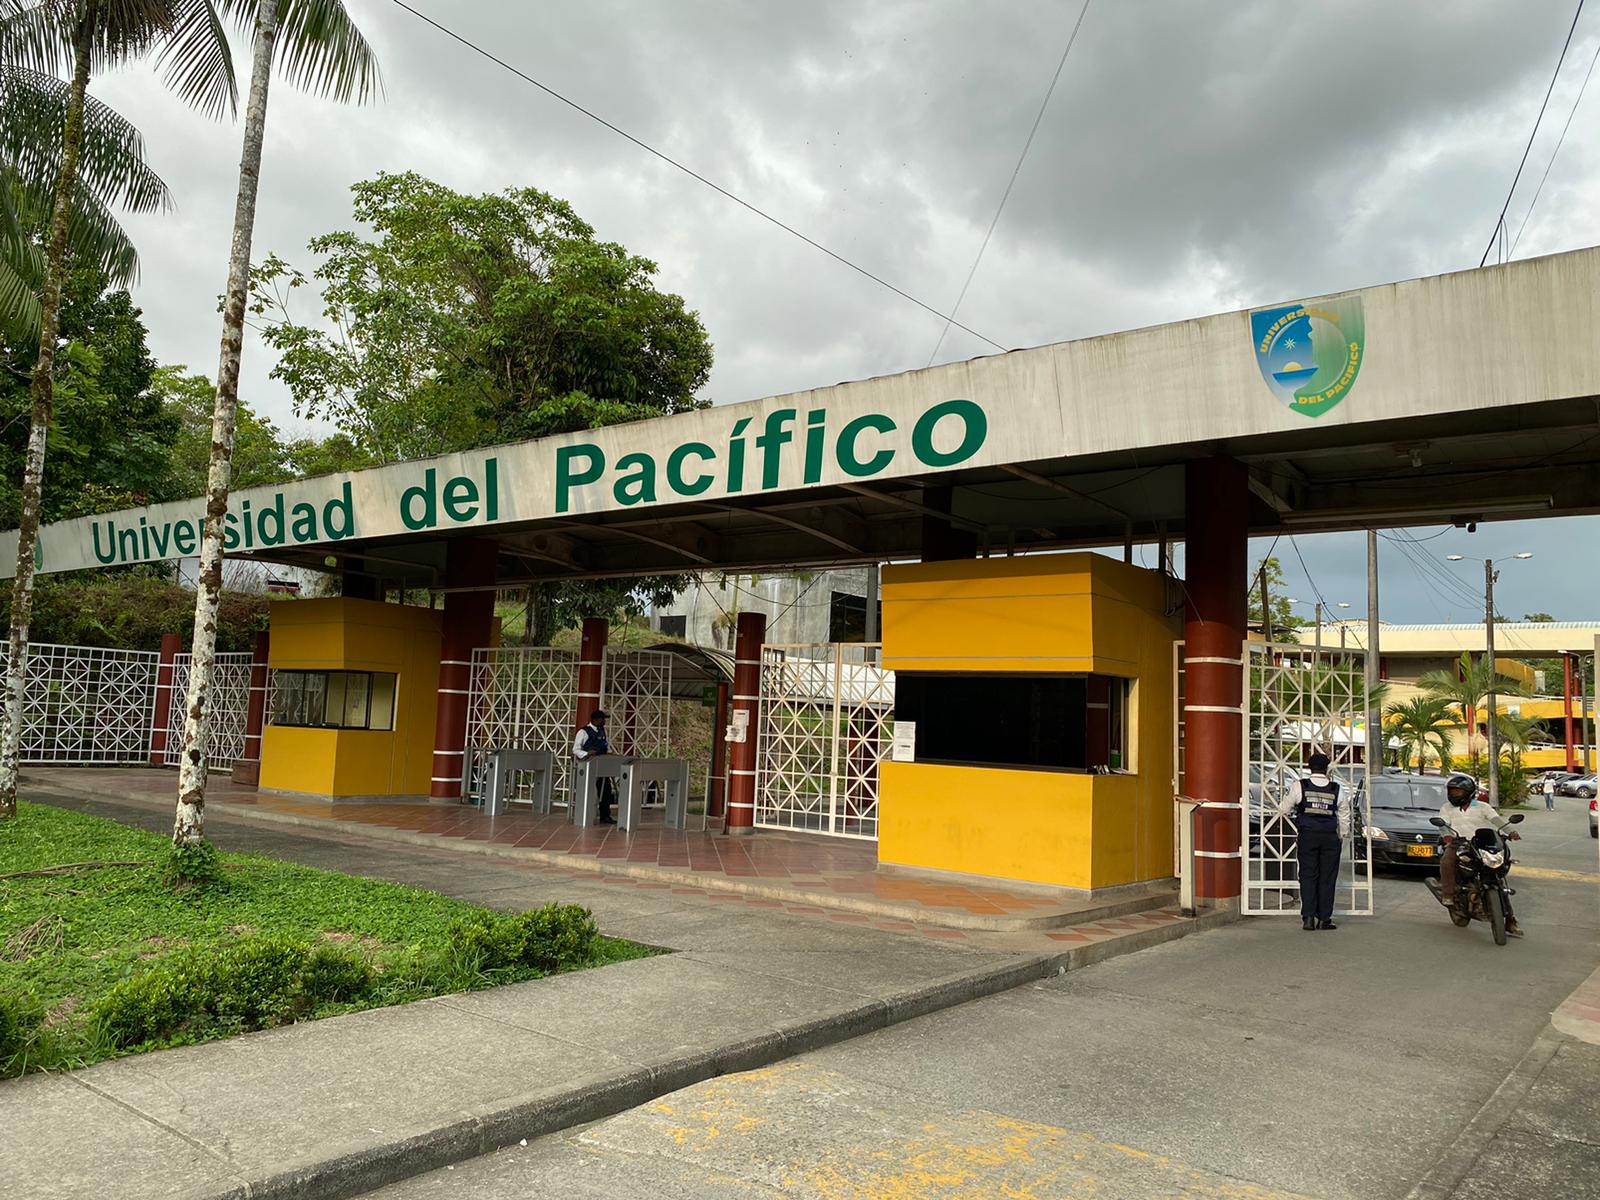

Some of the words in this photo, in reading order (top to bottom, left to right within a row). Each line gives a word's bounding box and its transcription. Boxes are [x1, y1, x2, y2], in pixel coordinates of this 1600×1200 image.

[1260, 307, 1339, 353] UNIVERSI
[1298, 394, 1324, 405] DEL
[400, 457, 499, 531] del
[555, 399, 988, 513] Pacífico
